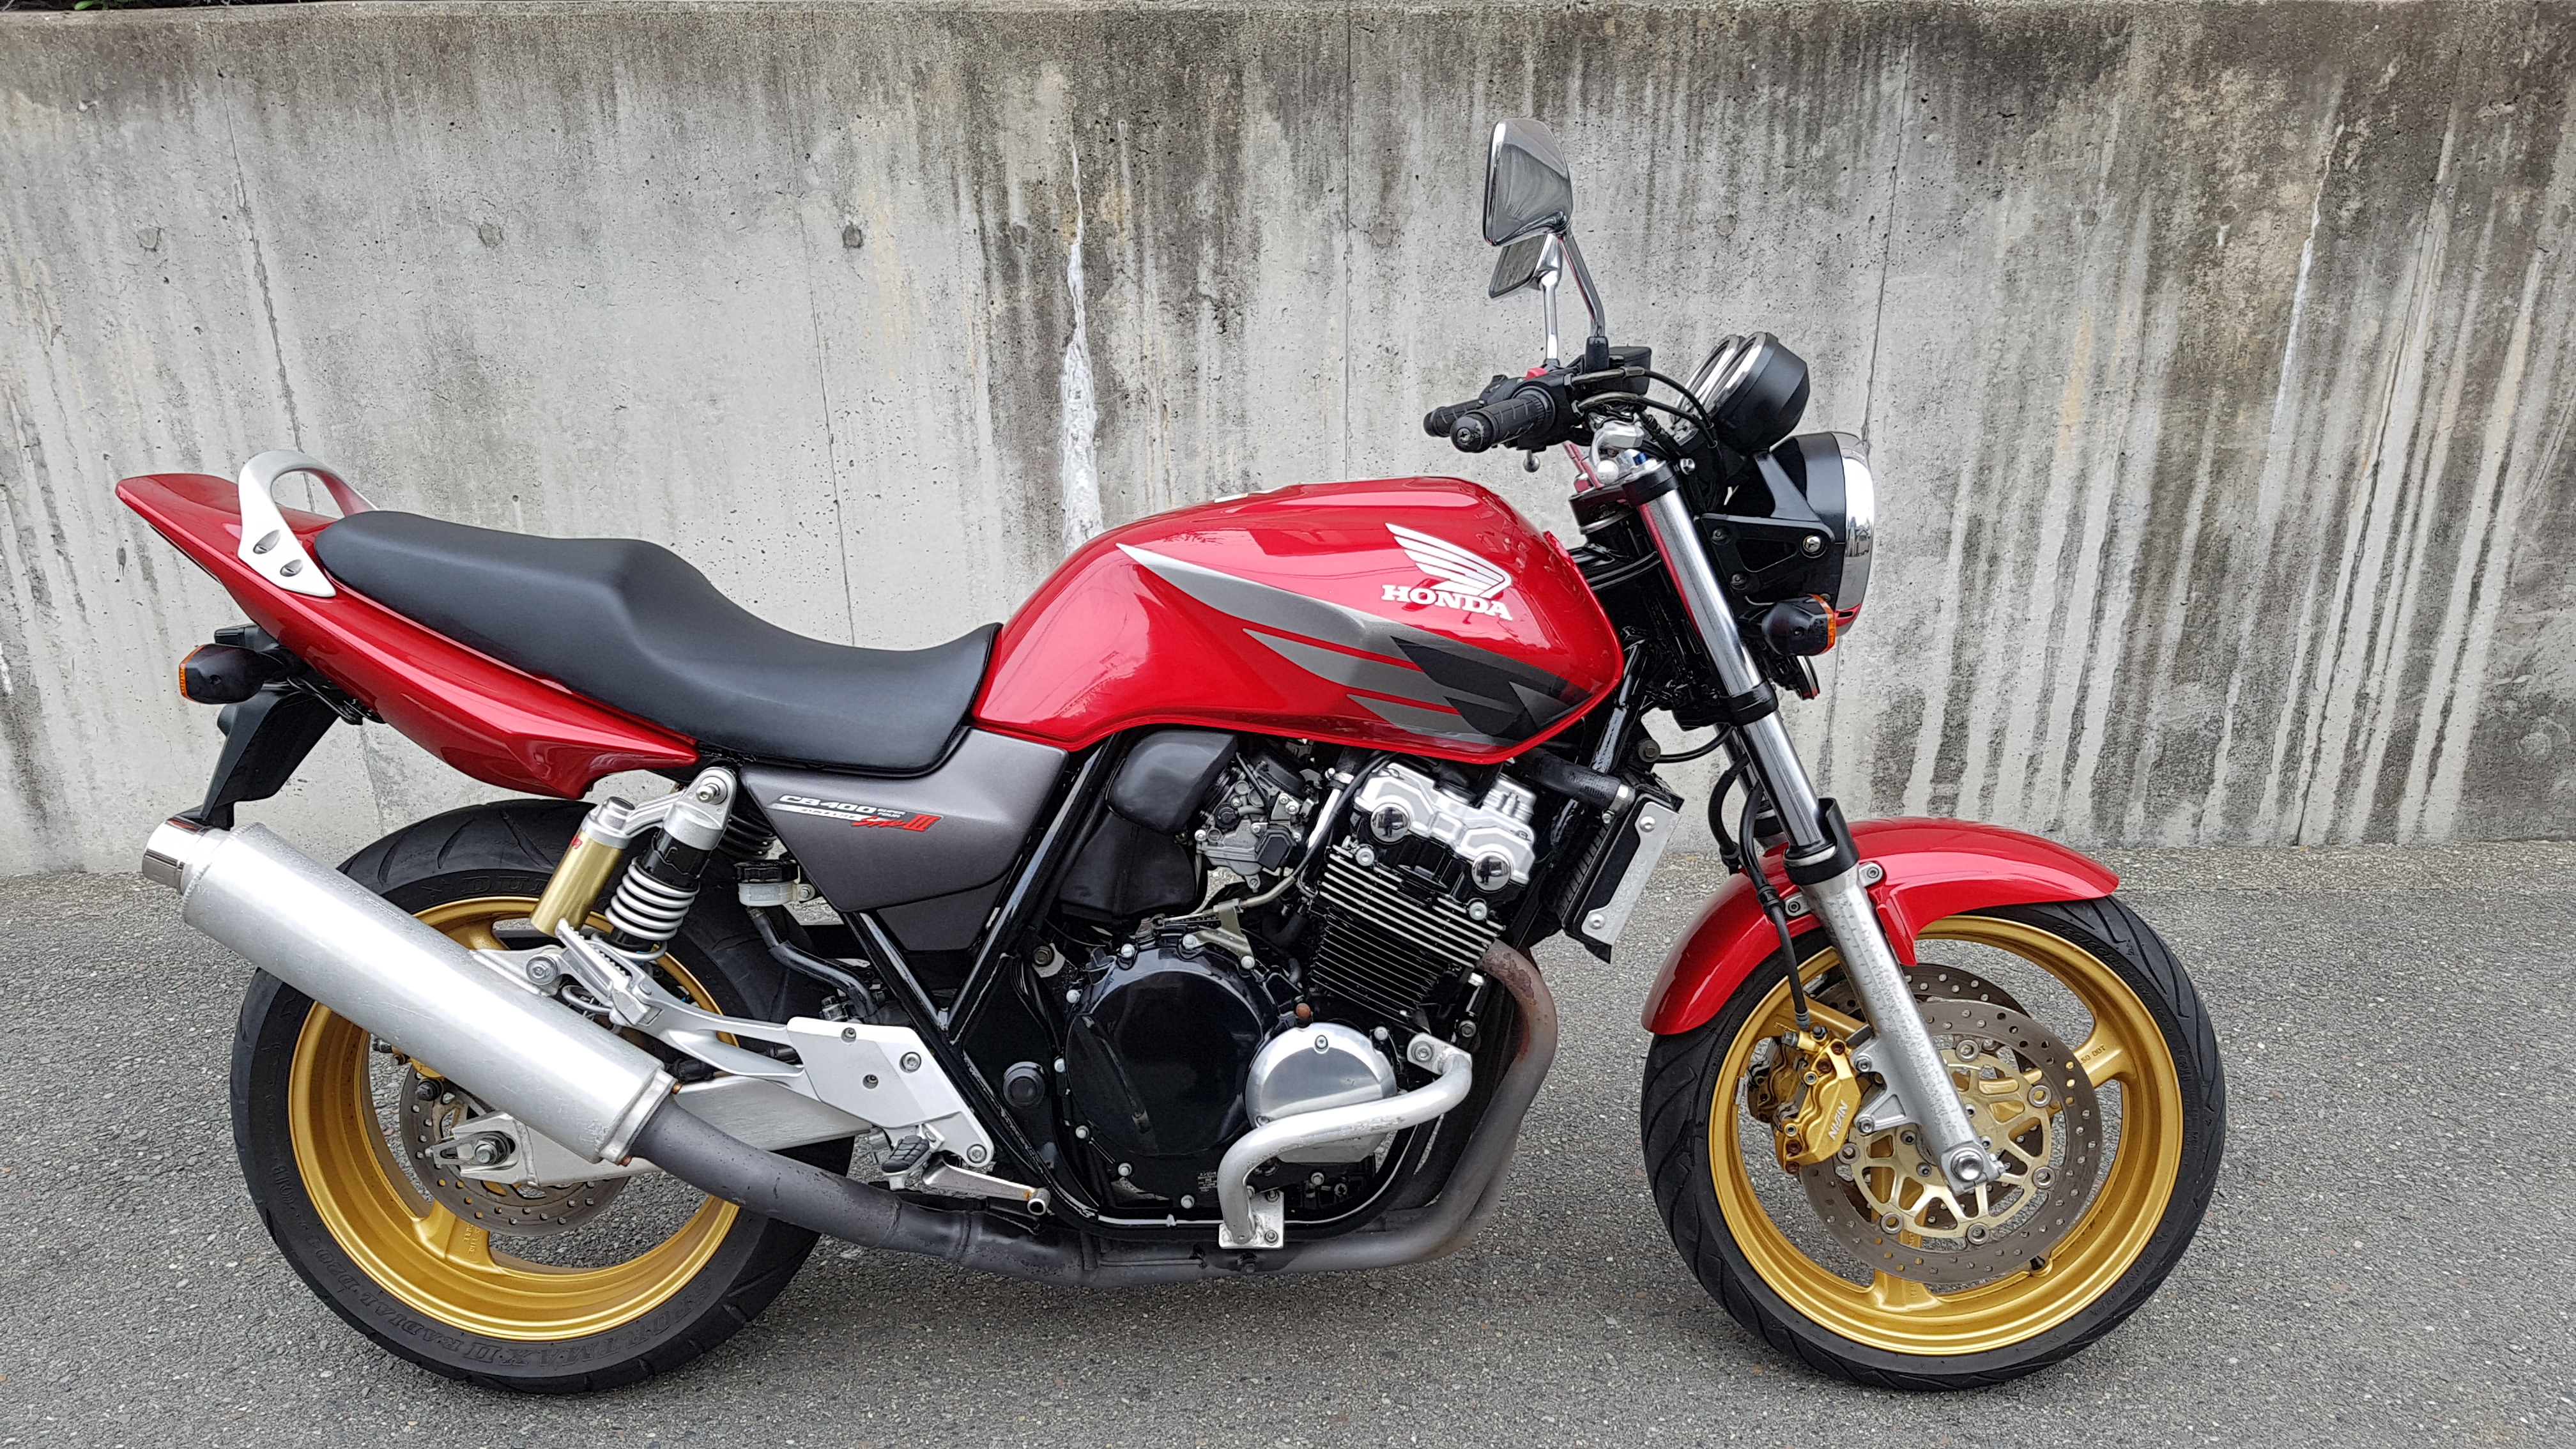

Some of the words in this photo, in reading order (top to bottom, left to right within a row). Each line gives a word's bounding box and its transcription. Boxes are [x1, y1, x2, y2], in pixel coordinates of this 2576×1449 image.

[1381, 585, 1513, 620] HONDA
[779, 795, 877, 814] CB400
[358, 1292, 462, 1354] RADIAL
